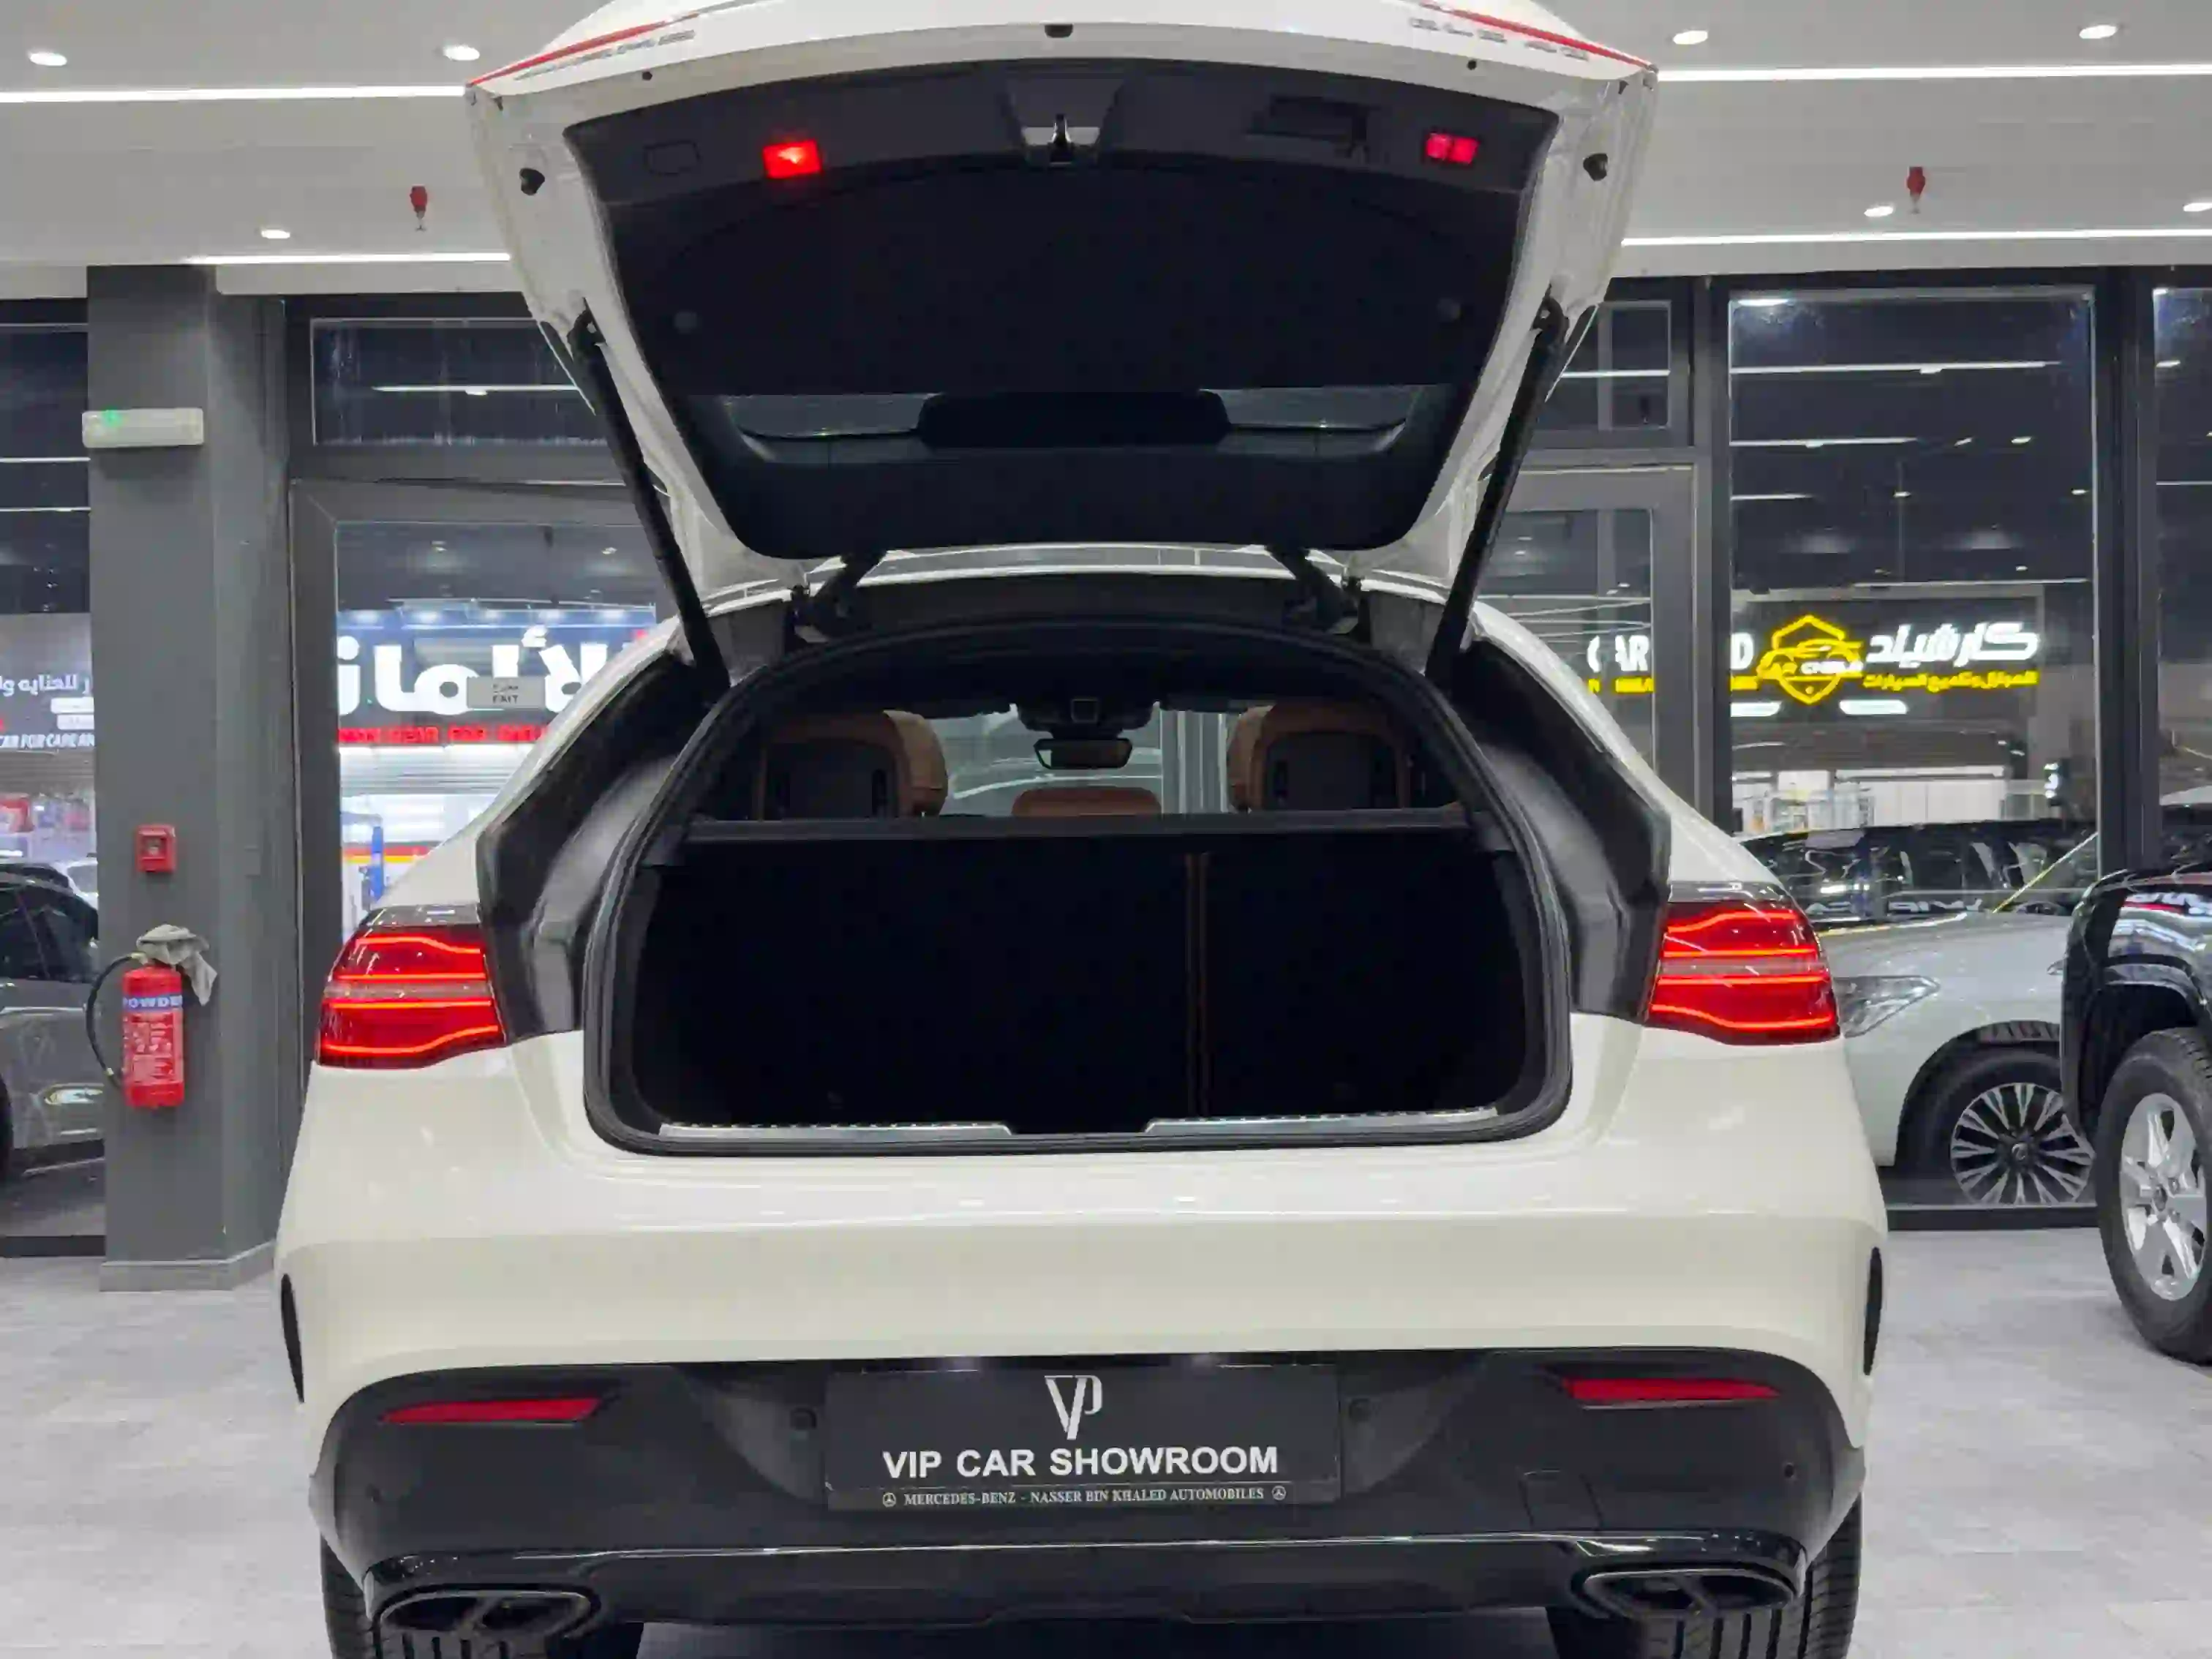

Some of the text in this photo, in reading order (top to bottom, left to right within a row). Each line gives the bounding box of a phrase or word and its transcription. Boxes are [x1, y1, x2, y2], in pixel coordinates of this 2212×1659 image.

[1865, 622, 2040, 669] كارشيلد
[883, 1445, 1278, 1478] VIP CAR SHOWROOM
[904, 1491, 1016, 1505] MERCEDES-BENZ
[1030, 1490, 1083, 1504] NASSER
[1086, 1489, 1109, 1502] BIN
[1112, 1489, 1167, 1502] KHALED
[1170, 1487, 1265, 1501] AUTOMOBILES
